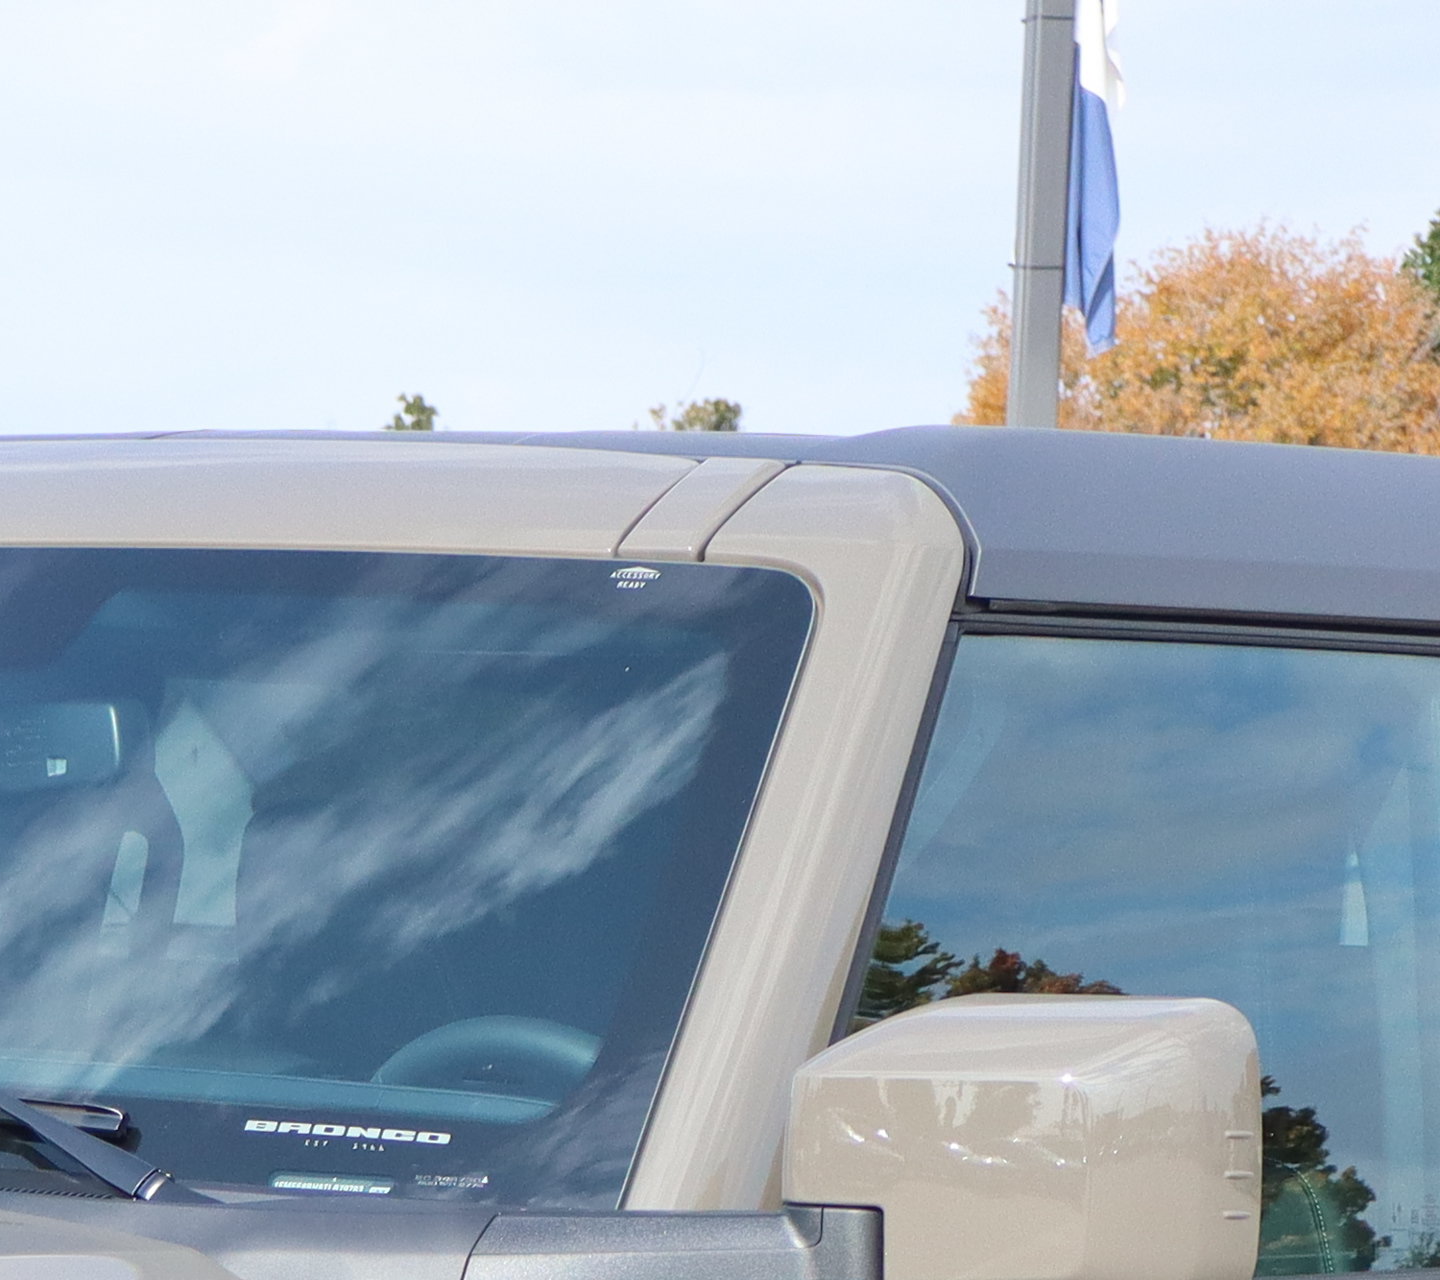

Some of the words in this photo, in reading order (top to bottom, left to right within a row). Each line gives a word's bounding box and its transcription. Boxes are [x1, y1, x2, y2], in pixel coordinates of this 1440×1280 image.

[609, 571, 661, 580] ACCESSORY
[616, 581, 646, 589] READY
[244, 1119, 452, 1145] BRONCO
